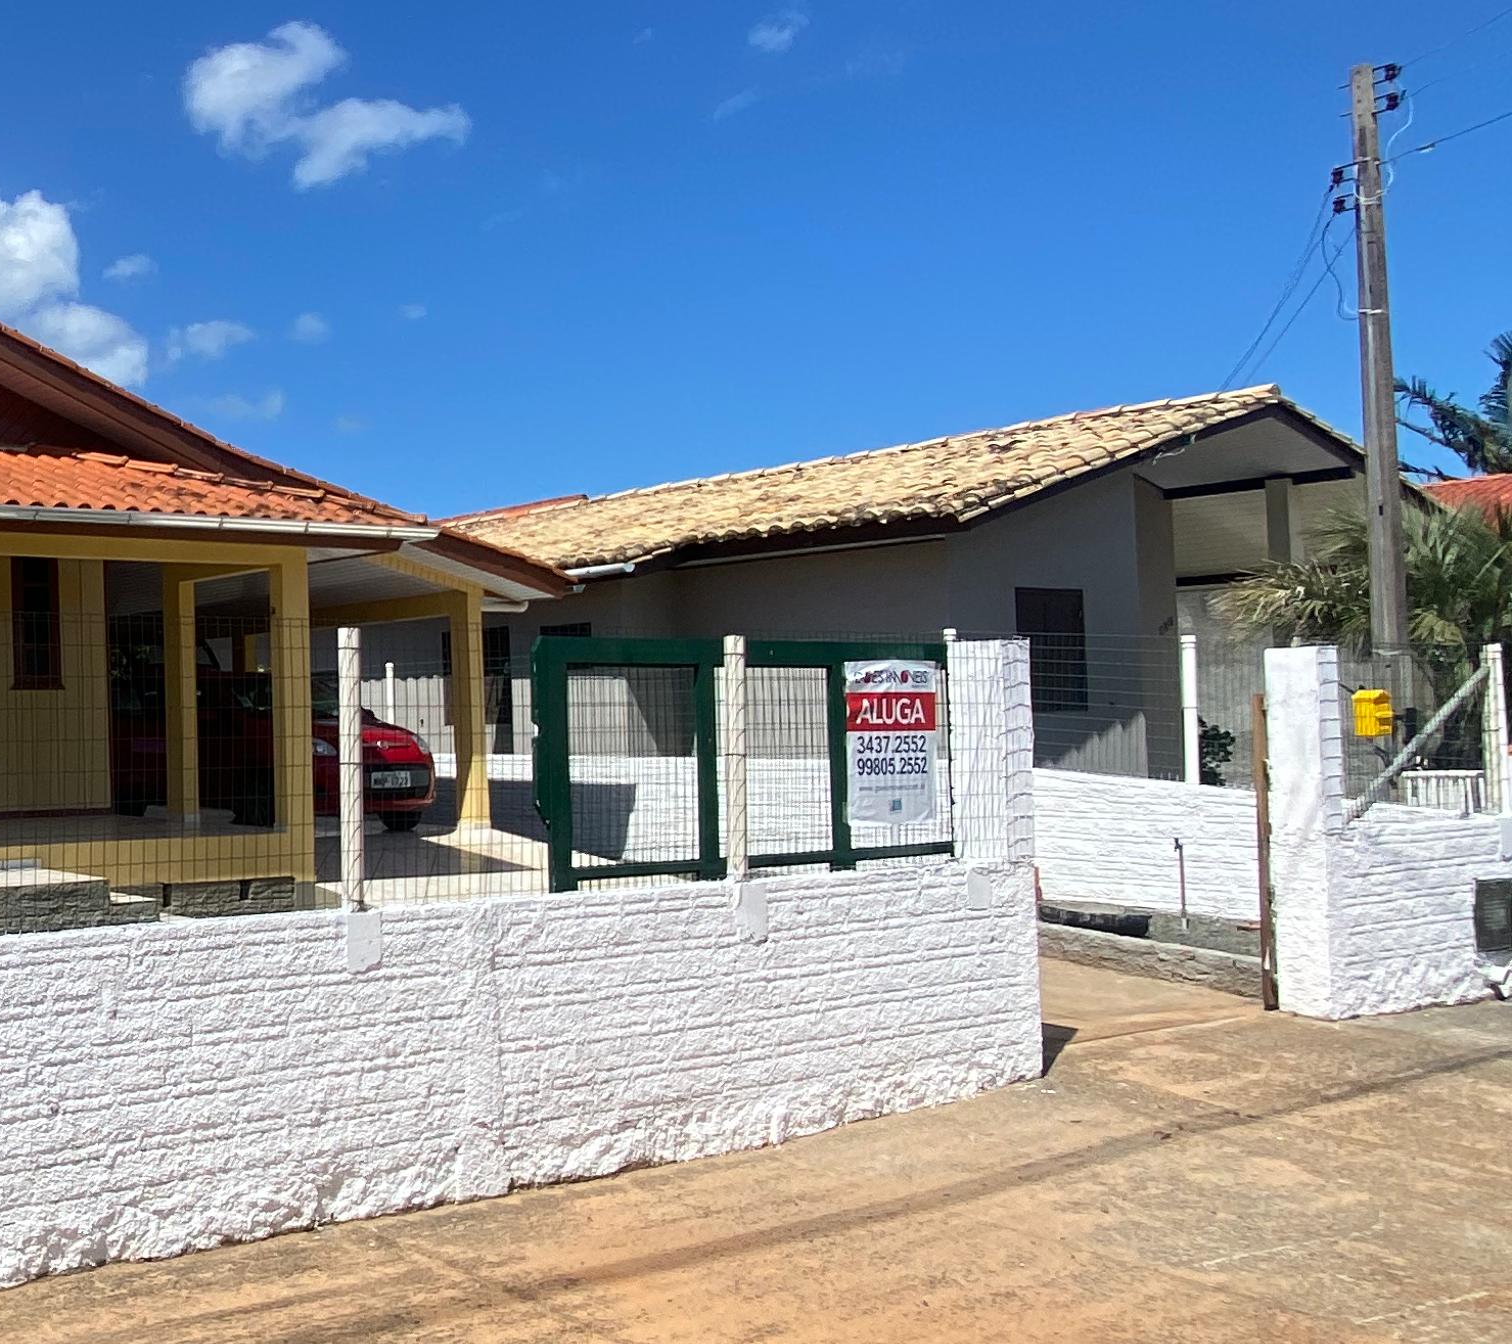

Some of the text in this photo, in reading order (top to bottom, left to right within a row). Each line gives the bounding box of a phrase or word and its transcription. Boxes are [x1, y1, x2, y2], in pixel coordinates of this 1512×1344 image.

[855, 698, 926, 725] ALUGA
[857, 735, 927, 754] 3437.2552
[857, 757, 928, 776] 99805.2552
